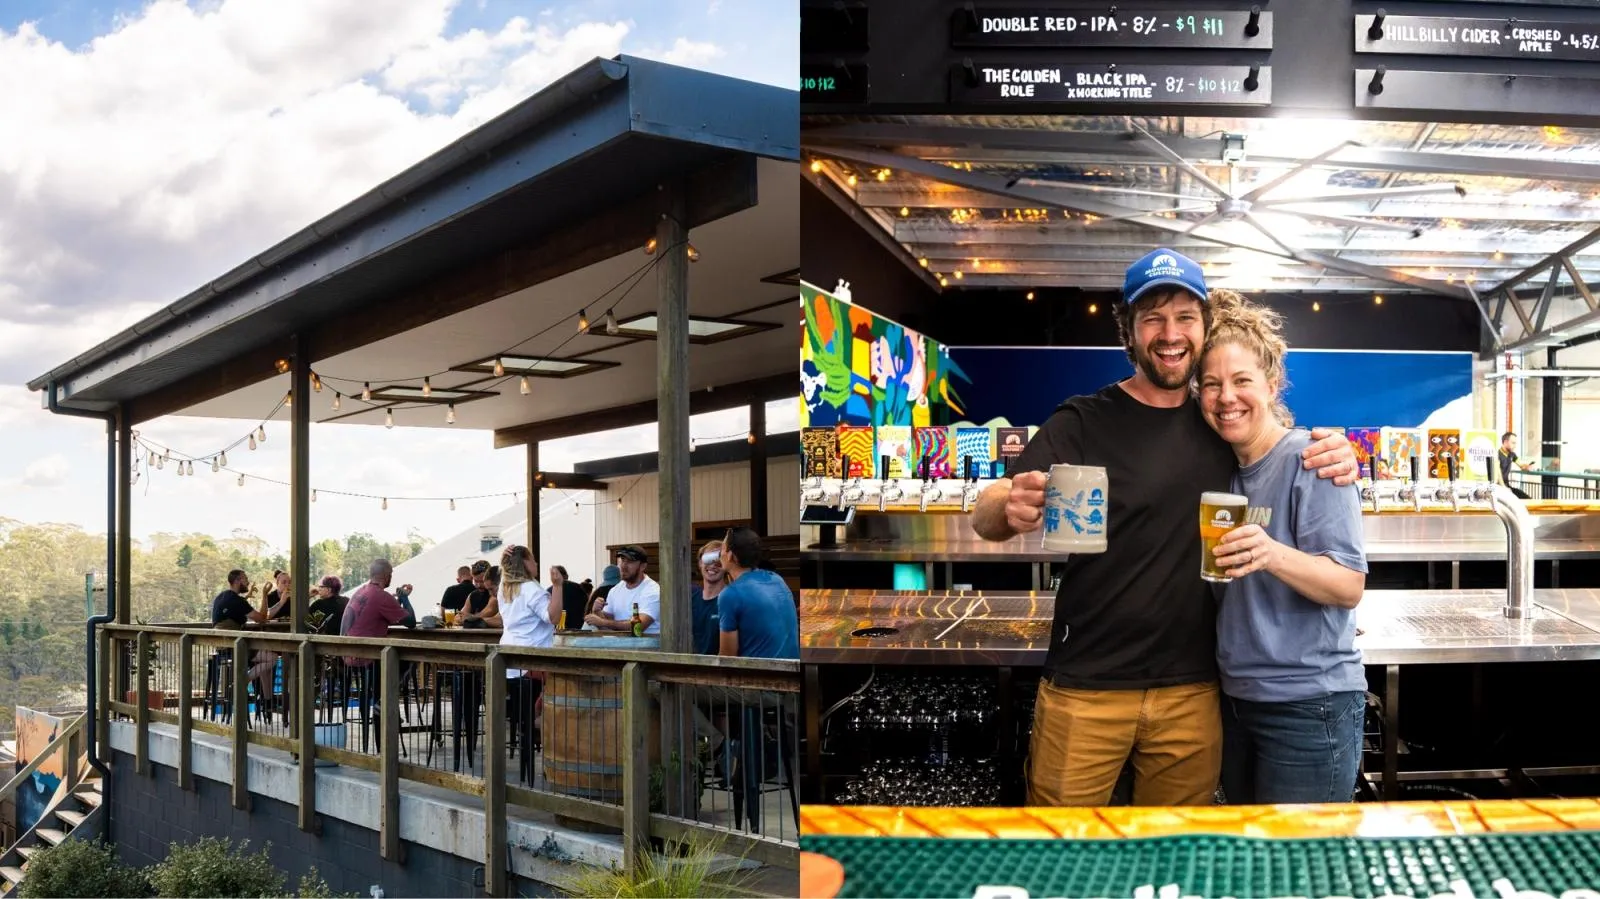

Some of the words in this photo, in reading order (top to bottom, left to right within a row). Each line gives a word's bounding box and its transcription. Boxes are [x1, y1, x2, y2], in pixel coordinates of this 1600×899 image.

[982, 16, 1039, 33] DOUBLE
[1044, 16, 1077, 31] RED
[1091, 16, 1118, 32] IPA
[1133, 16, 1157, 35] 8%
[1176, 15, 1196, 34] $9
[1202, 17, 1223, 36] $11
[1385, 24, 1458, 43] HILLBILLY
[1461, 28, 1501, 45] CIDER
[1512, 28, 1562, 41] CRUSHED
[1518, 41, 1553, 52] APPLE
[982, 68, 1011, 83] THE
[1011, 68, 1061, 83] GOLDEN
[818, 76, 836, 92] $12
[1000, 84, 1035, 97] RULE
[1076, 73, 1123, 86] BLACK
[1125, 73, 1147, 86] IPA
[1165, 76, 1185, 93] 8%
[1198, 77, 1217, 94] $10
[1220, 78, 1241, 94] $12
